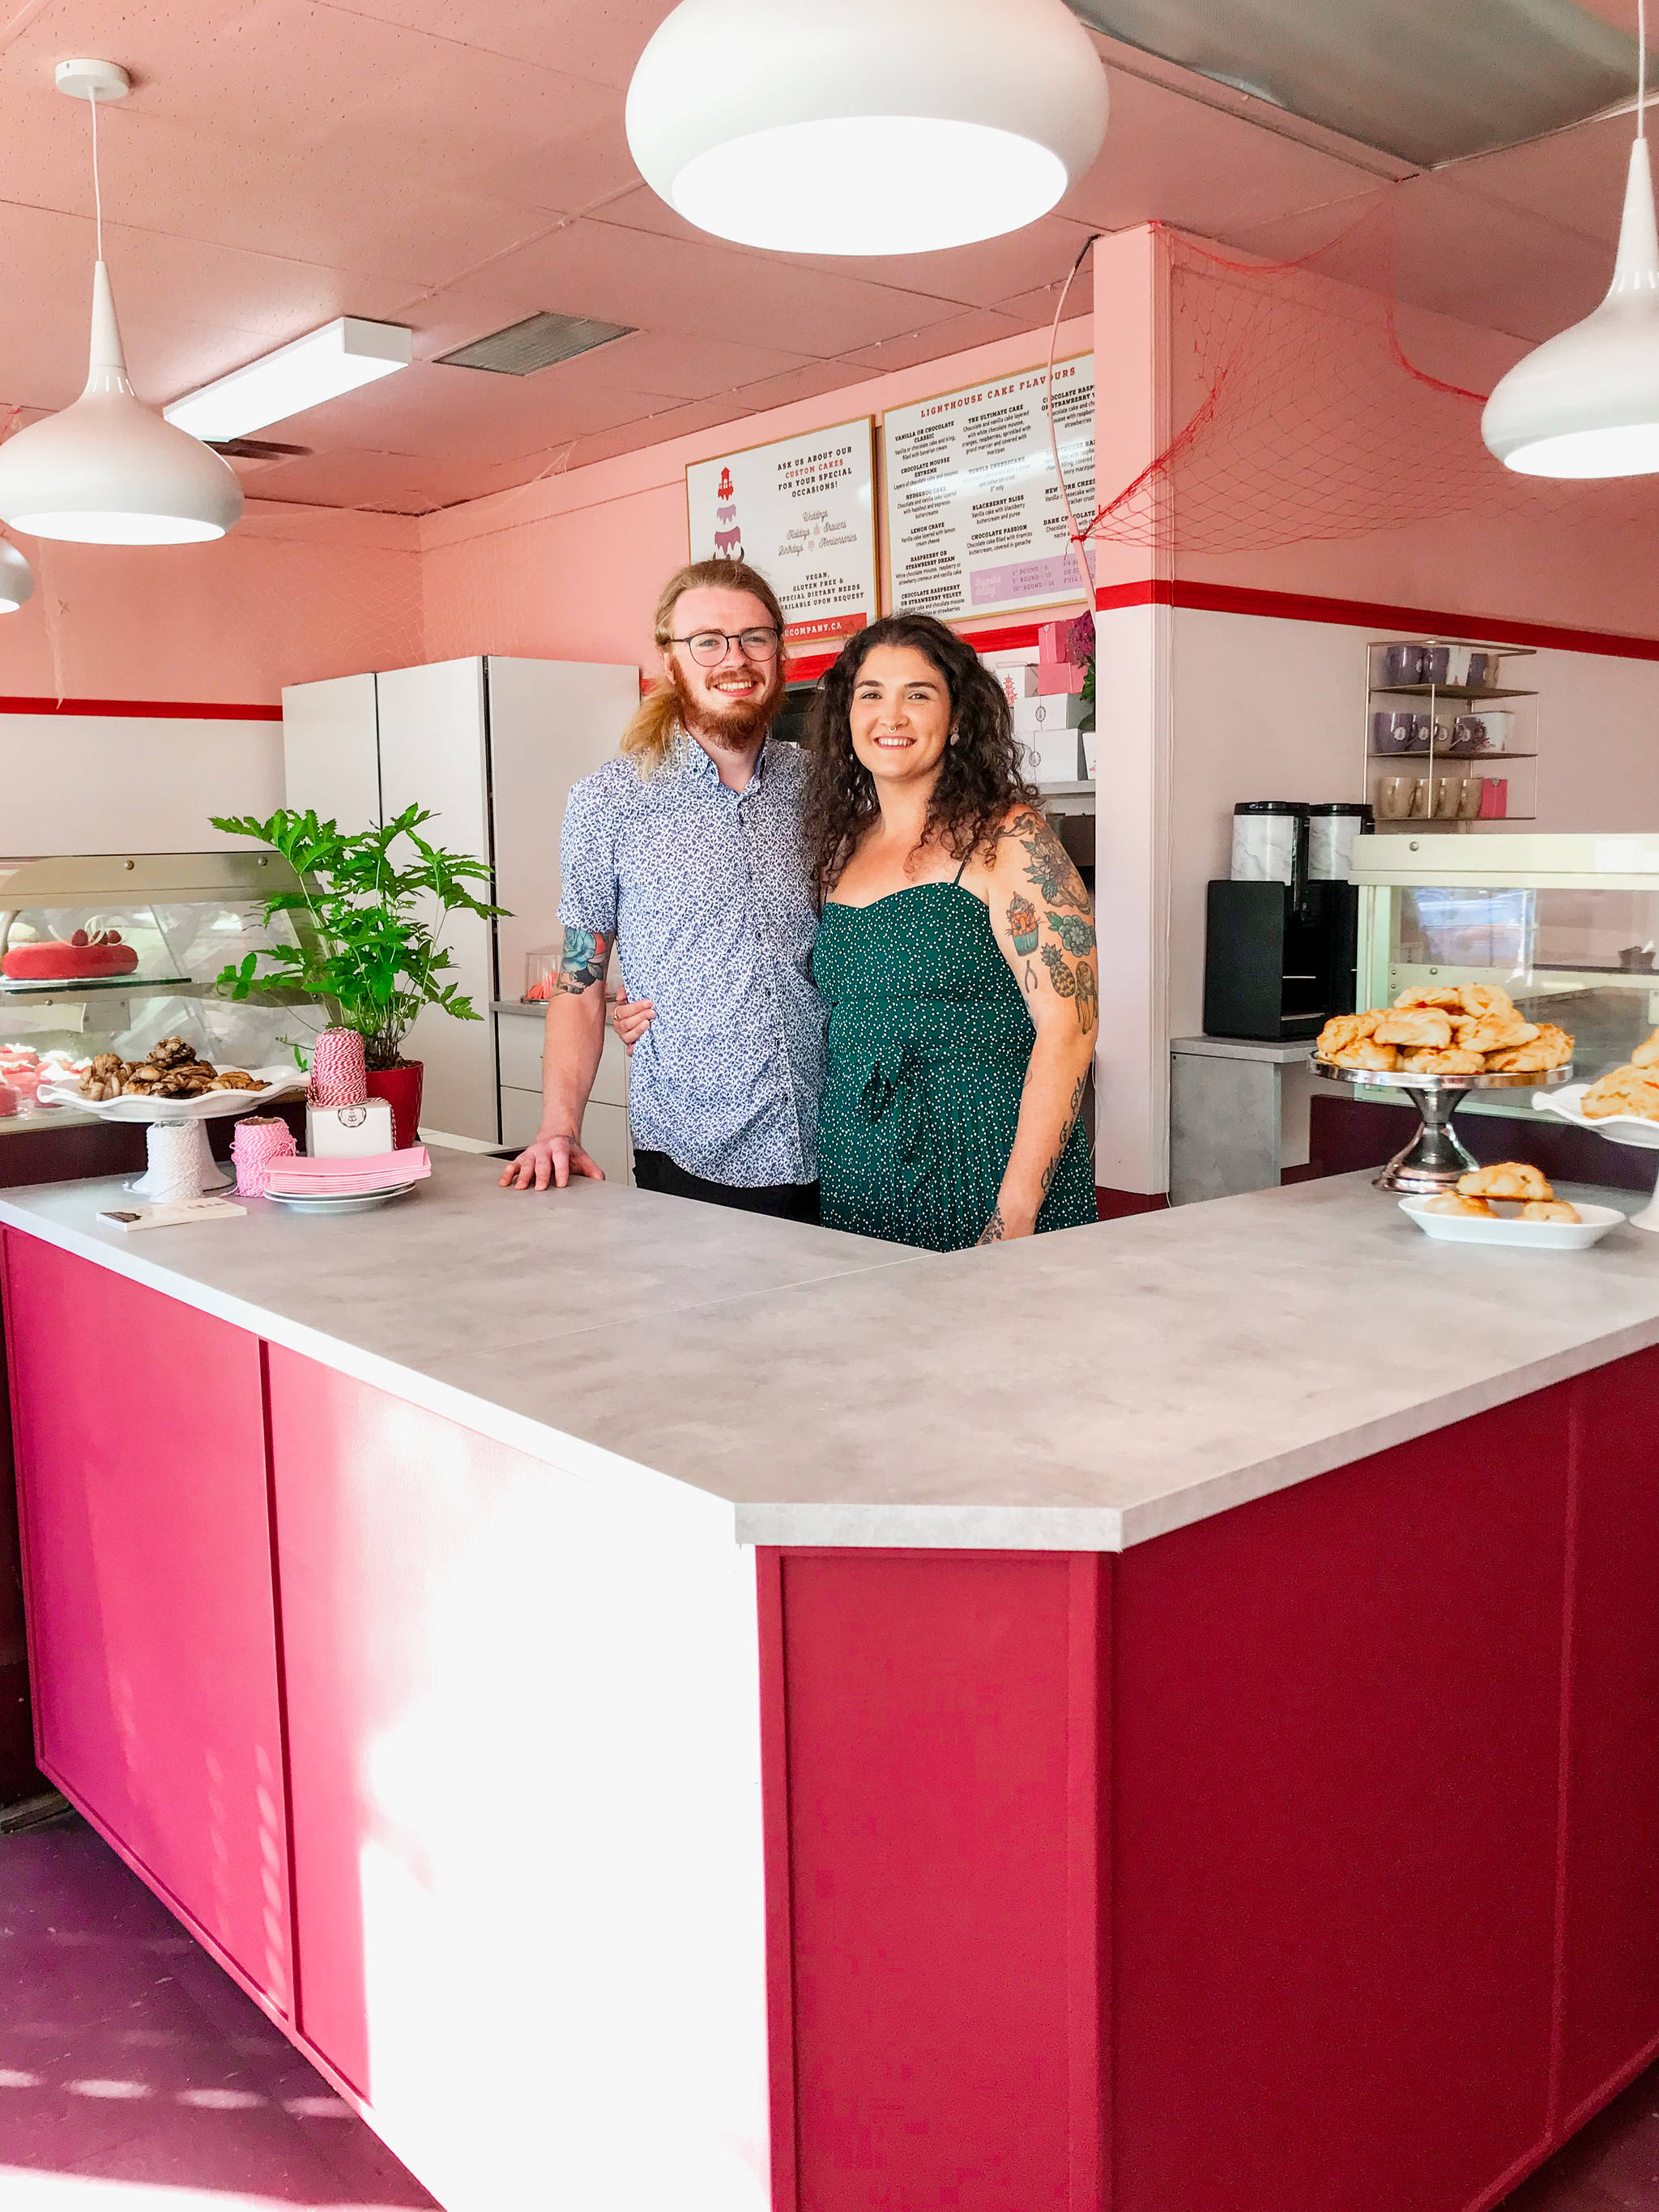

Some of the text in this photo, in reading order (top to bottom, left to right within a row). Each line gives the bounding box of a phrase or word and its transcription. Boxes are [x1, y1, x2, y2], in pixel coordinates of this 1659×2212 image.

[920, 391, 983, 418] LIGHTHOUSE
[987, 386, 1014, 399] CAKE
[980, 409, 1007, 420] ULTIMATE
[1009, 404, 1023, 412] CAKE
[895, 432, 915, 441] VANILLA
[925, 421, 954, 433] CHOCOLATE
[915, 433, 934, 443] CLASSIC
[777, 462, 791, 471] ASK
[808, 451, 833, 463] ABOUT
[836, 446, 852, 455] OUR
[786, 458, 843, 479] CUSTOM CAKES
[901, 457, 949, 474] CHOCOLATE MOUSSE
[969, 466, 988, 474] TURTLE
[778, 467, 852, 490] FOR YOUR SPECIAL
[915, 468, 936, 477] EXTREME
[791, 481, 838, 497] OCCASIONS!
[894, 482, 905, 490] Layers
[973, 499, 1007, 510] BLACKBERRY
[803, 509, 828, 522] Weddings
[911, 526, 927, 534] LEMON
[971, 525, 1027, 540] CHOCOLATE PASSION
[1046, 524, 1066, 532] Chocolate
[819, 534, 857, 548] Anniversaries
[911, 552, 939, 562] RASPBERRY
[906, 559, 936, 570] STRAWBERRY
[806, 572, 830, 581] VEGAN,
[1021, 574, 1039, 582] ROUND
[793, 583, 817, 591] GLUTEN
[821, 578, 836, 586] FREE
[778, 584, 860, 603] SPECIAL DIETARY NEEDS
[834, 592, 864, 602] REQUEST
[902, 584, 960, 599] CHOCOLATE RASPBERRY
[909, 595, 940, 605] STRAWBERRY
